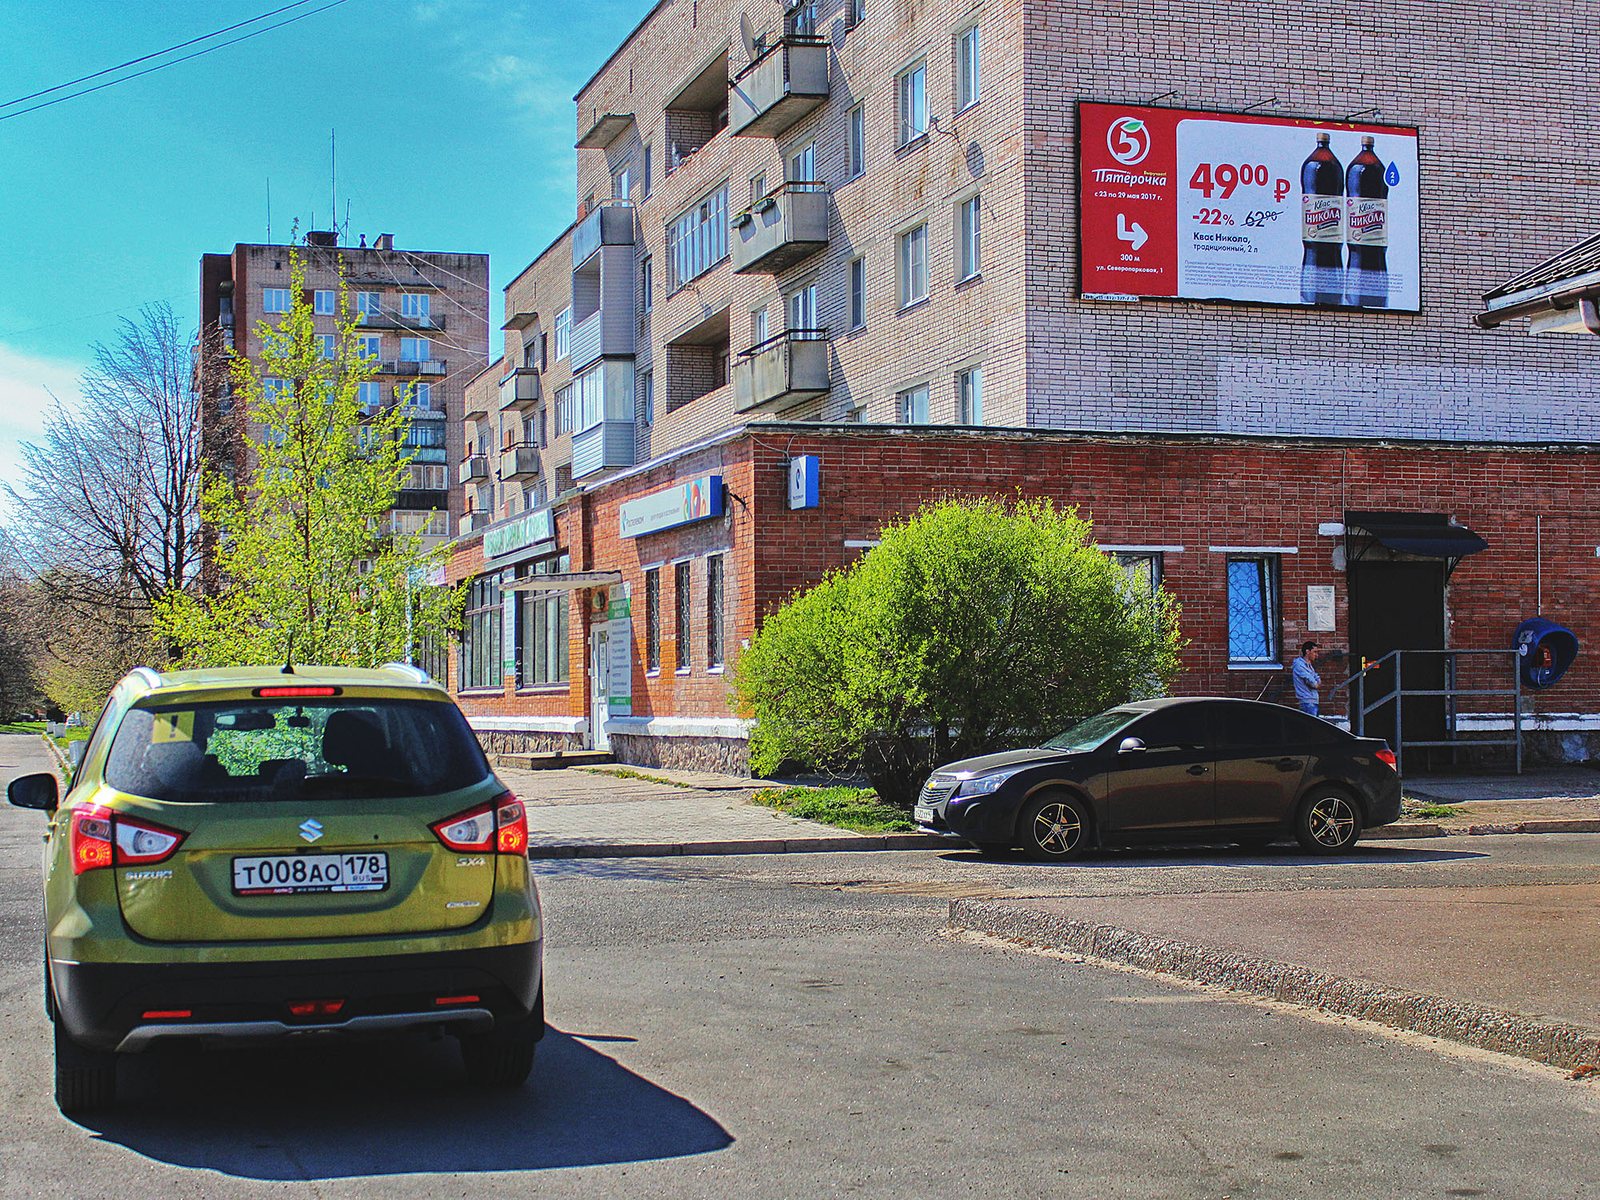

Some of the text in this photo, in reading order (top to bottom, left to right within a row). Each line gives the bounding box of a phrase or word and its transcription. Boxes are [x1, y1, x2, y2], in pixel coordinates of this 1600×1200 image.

[1306, 209, 1340, 223] НИКОЛА
[1351, 212, 1384, 226] НИКОЛА
[1193, 232, 1250, 244] Квас Никола,
[1193, 243, 1246, 253] традиционный,
[1247, 245, 1252, 253] 2
[345, 856, 380, 874] 178
[456, 858, 486, 867] SX4
[126, 870, 173, 880] SUZUKI
